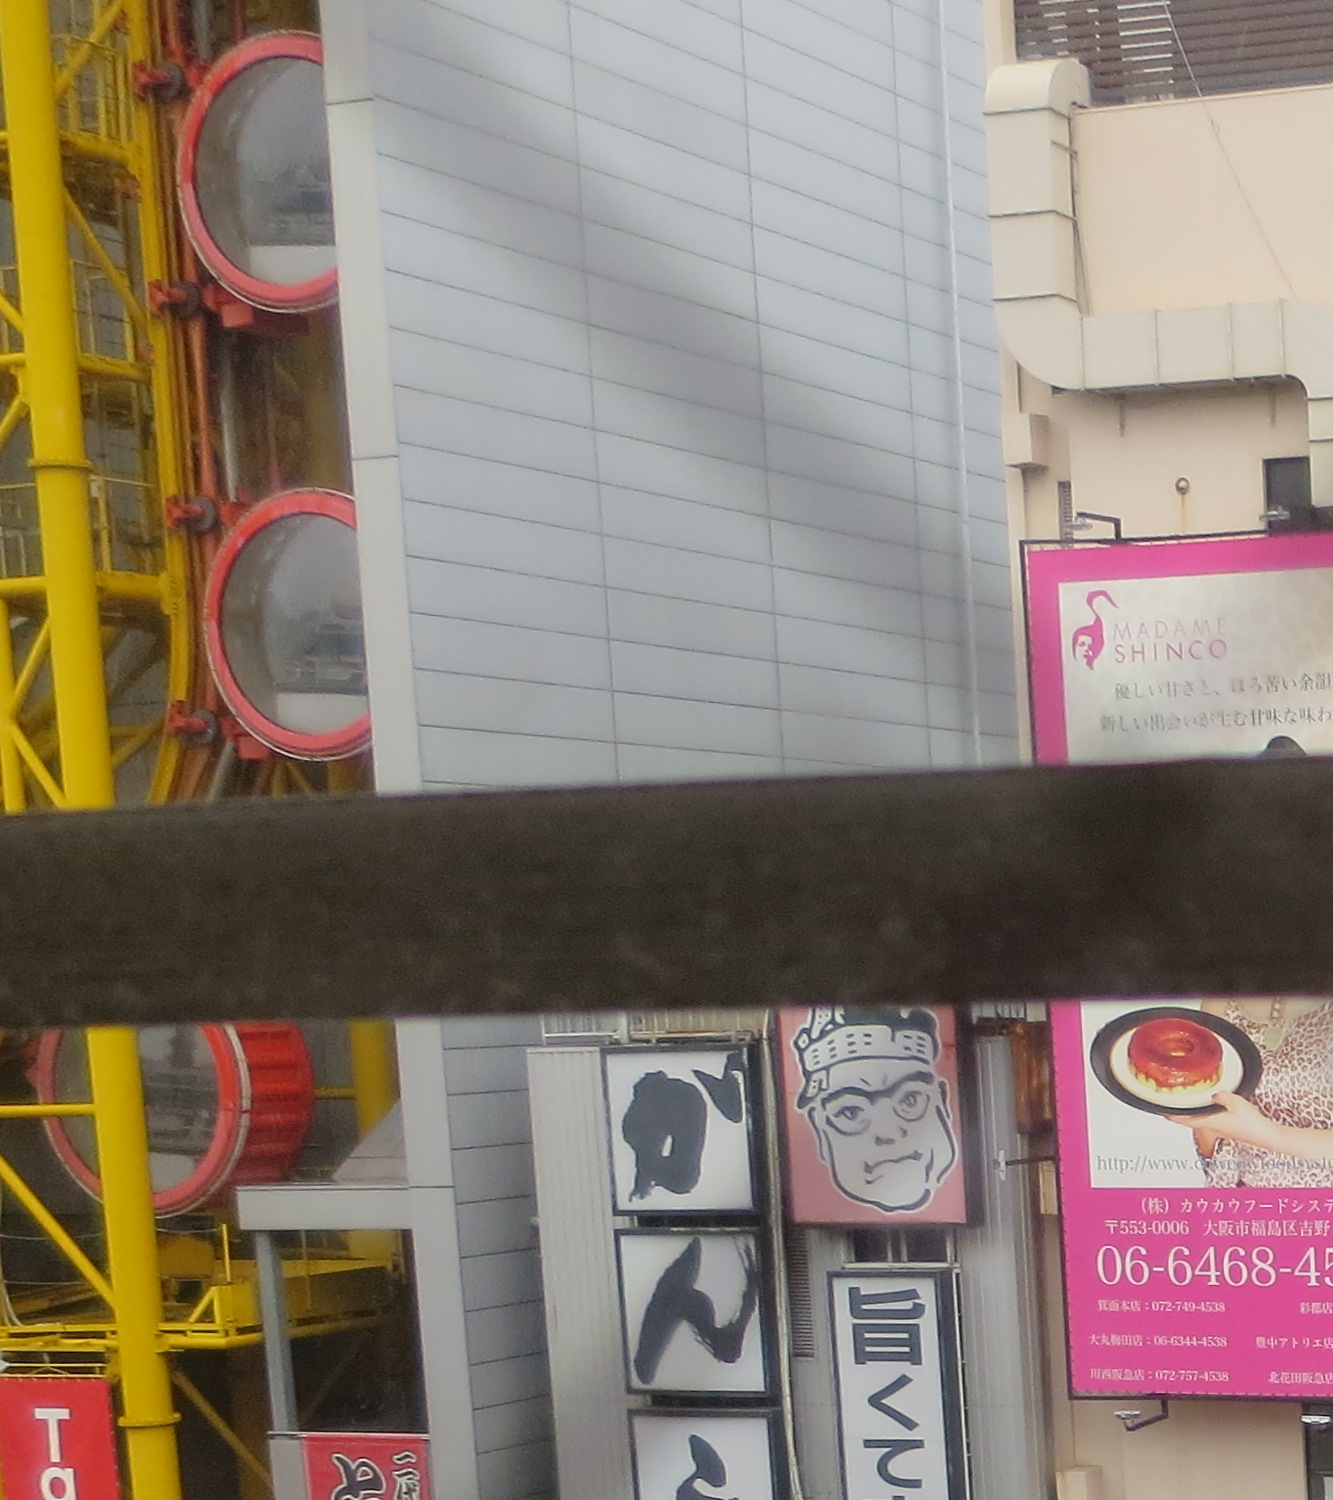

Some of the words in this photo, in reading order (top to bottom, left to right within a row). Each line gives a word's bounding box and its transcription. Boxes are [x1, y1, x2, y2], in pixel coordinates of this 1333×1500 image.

[1113, 617, 1228, 640] MADAME
[1113, 639, 1228, 664] SHINCO
[1202, 1219, 1329, 1238] 大阪市福島区吉野
